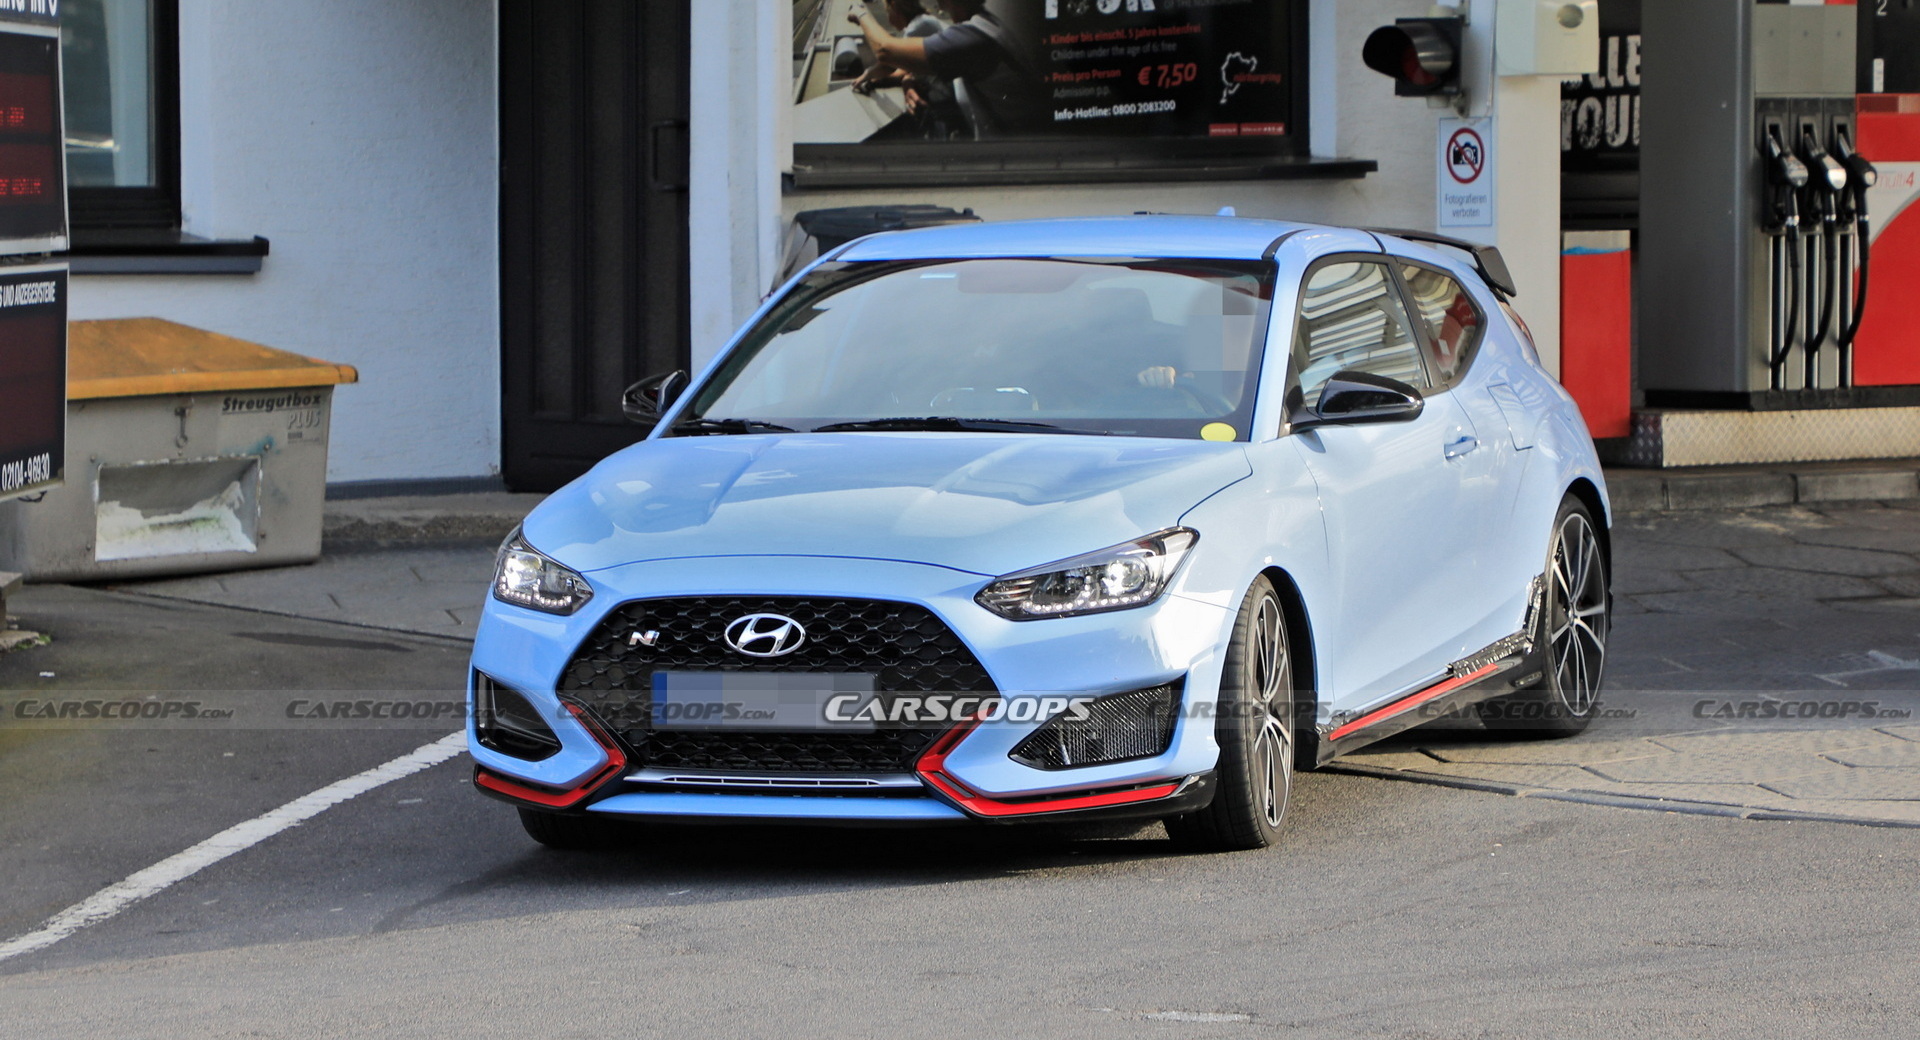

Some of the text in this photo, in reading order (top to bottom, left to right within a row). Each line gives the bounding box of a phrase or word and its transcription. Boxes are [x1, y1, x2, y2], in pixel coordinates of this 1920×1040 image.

[1051, 33, 1079, 44] Kinder
[1081, 31, 1093, 42] bis
[1128, 28, 1134, 38] 5
[1052, 48, 1087, 60] Children
[1088, 47, 1110, 58] under
[1111, 45, 1126, 56] the
[1053, 63, 1197, 88] Preis pro Person € 7,50
[1054, 87, 1095, 99] Admission
[1054, 100, 1176, 121] Info-Hotline: 0800 2083200
[1445, 193, 1487, 206] Fotografieren
[1452, 207, 1480, 217] verboten
[222, 392, 321, 412] Streugutbox
[287, 410, 321, 430] PLUS
